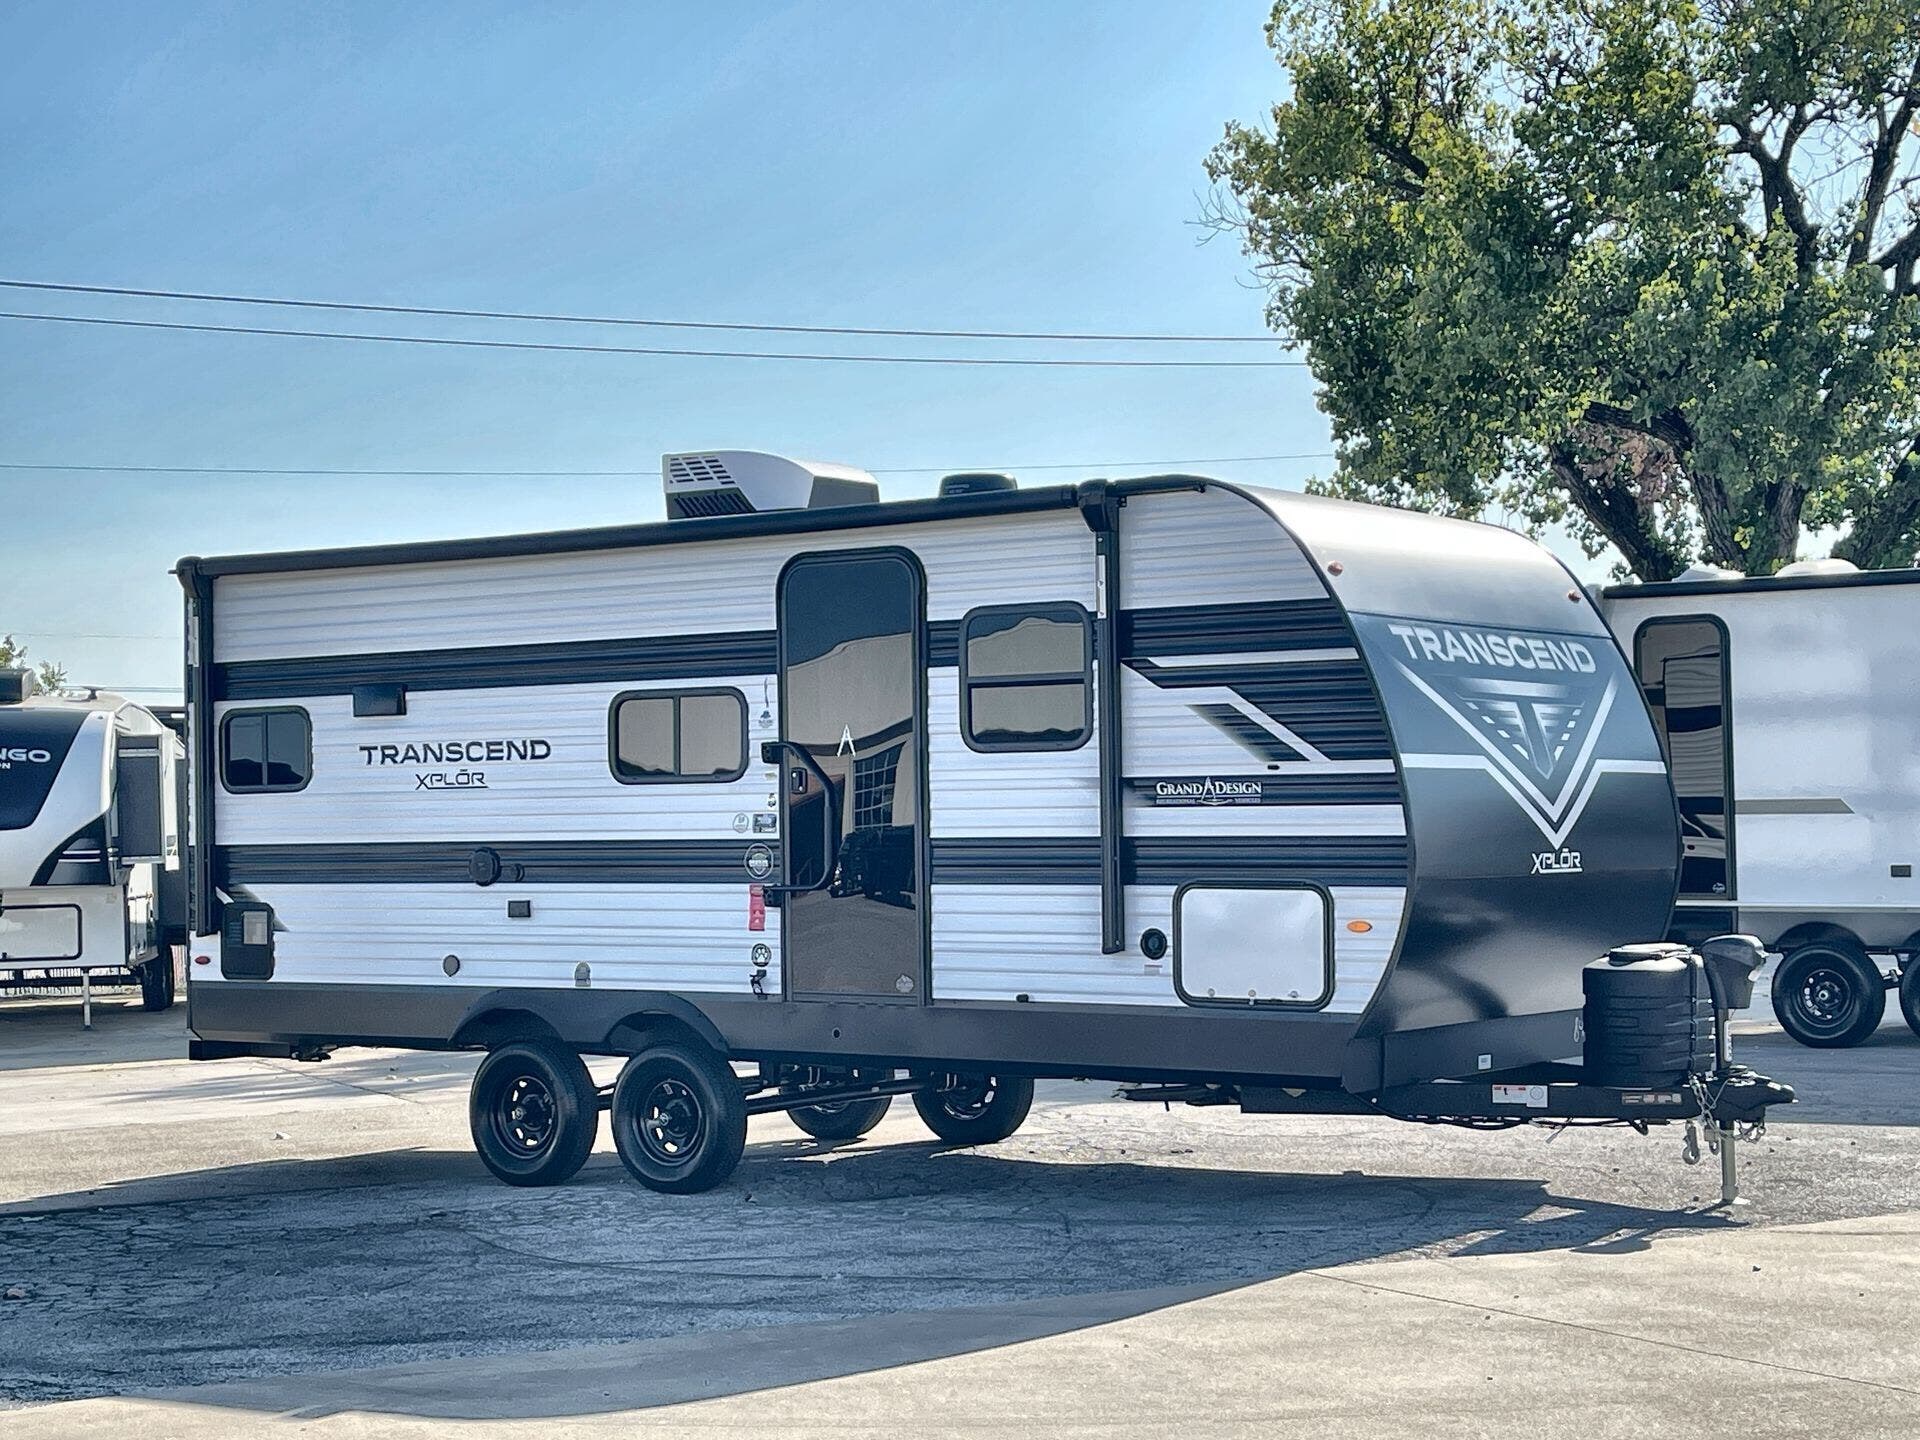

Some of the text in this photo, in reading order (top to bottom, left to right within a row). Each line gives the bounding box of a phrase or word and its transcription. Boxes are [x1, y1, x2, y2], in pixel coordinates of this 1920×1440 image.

[1387, 624, 1596, 674] TRANSCEND
[359, 739, 551, 765] TRANSCEND
[1156, 781, 1262, 795] GRAND DESIGN
